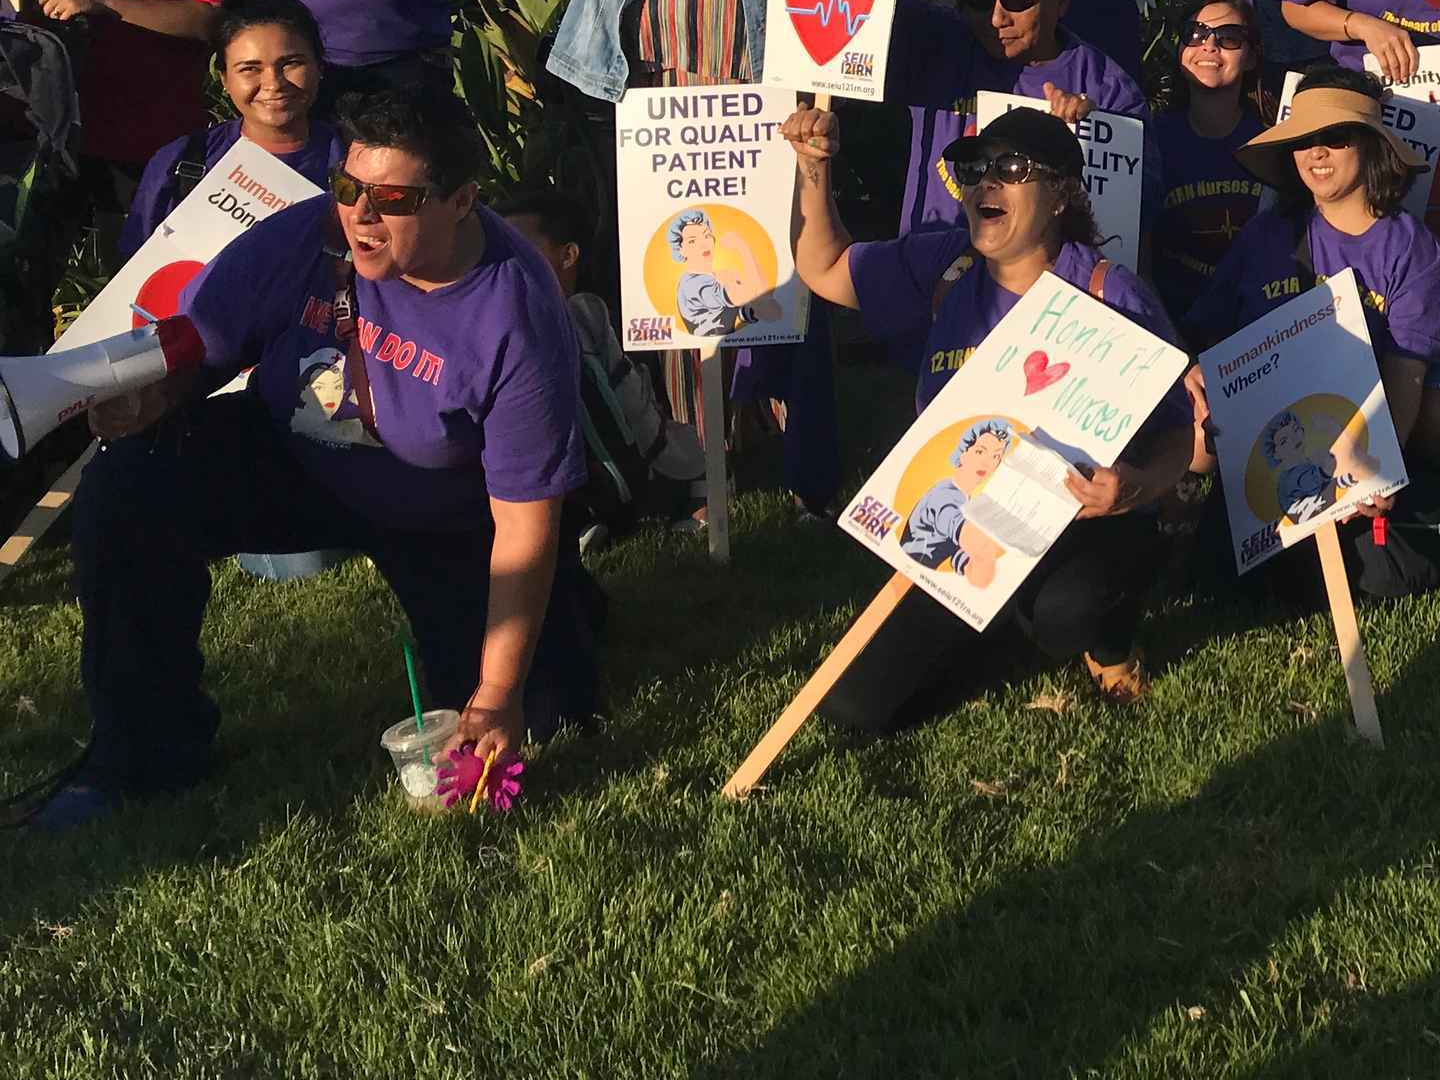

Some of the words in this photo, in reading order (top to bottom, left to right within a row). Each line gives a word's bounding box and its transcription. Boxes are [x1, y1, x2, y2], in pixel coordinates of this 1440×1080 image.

[647, 92, 763, 120] UNITED
[620, 127, 672, 148] FOR
[680, 121, 784, 145] QUALIT
[652, 149, 762, 172] PATIENT
[667, 177, 747, 198] CARE!
[1030, 289, 1123, 362] Honk
[1217, 295, 1343, 379] humankindness?
[376, 333, 417, 370] DO
[1223, 352, 1281, 399] Where?
[1052, 376, 1132, 443] Nurses
